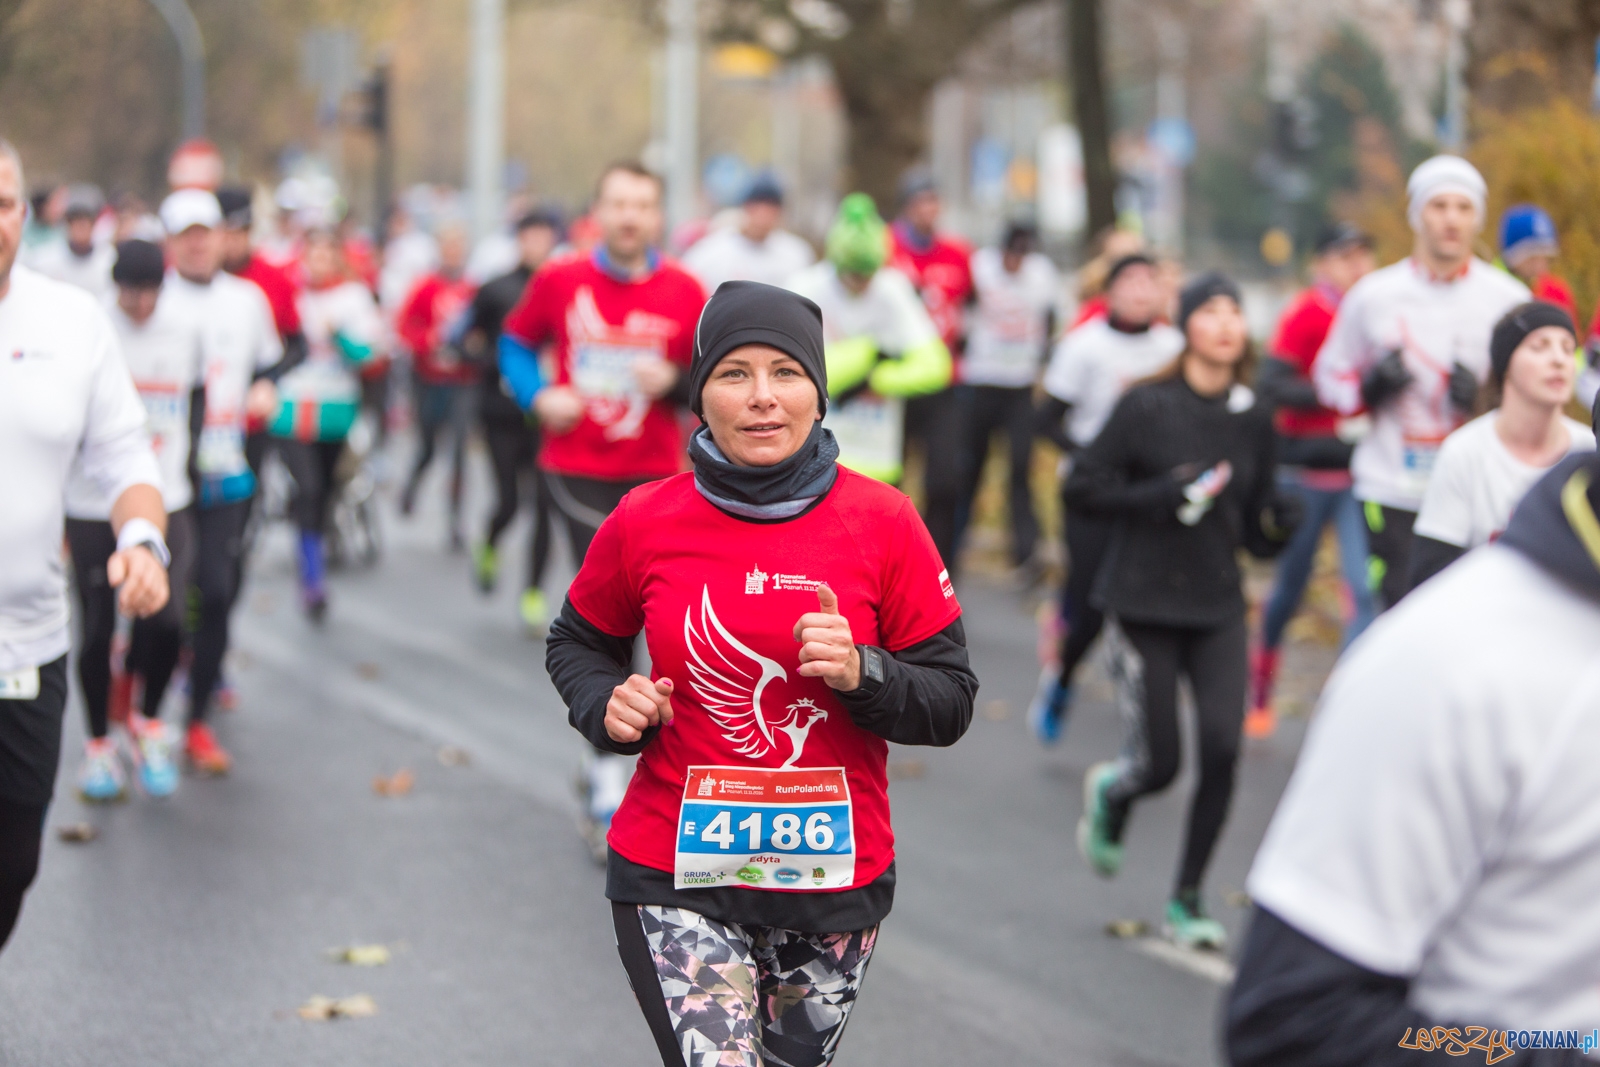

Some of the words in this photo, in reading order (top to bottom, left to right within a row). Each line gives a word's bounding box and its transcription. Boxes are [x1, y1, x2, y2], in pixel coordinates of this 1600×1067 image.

[772, 573, 782, 589] 1
[719, 779, 726, 793] 1
[775, 784, 839, 794] RunPoland.org
[684, 821, 696, 836] E
[701, 810, 835, 851] 4186
[749, 856, 781, 865] Edyta
[684, 876, 716, 884] LUXMED
